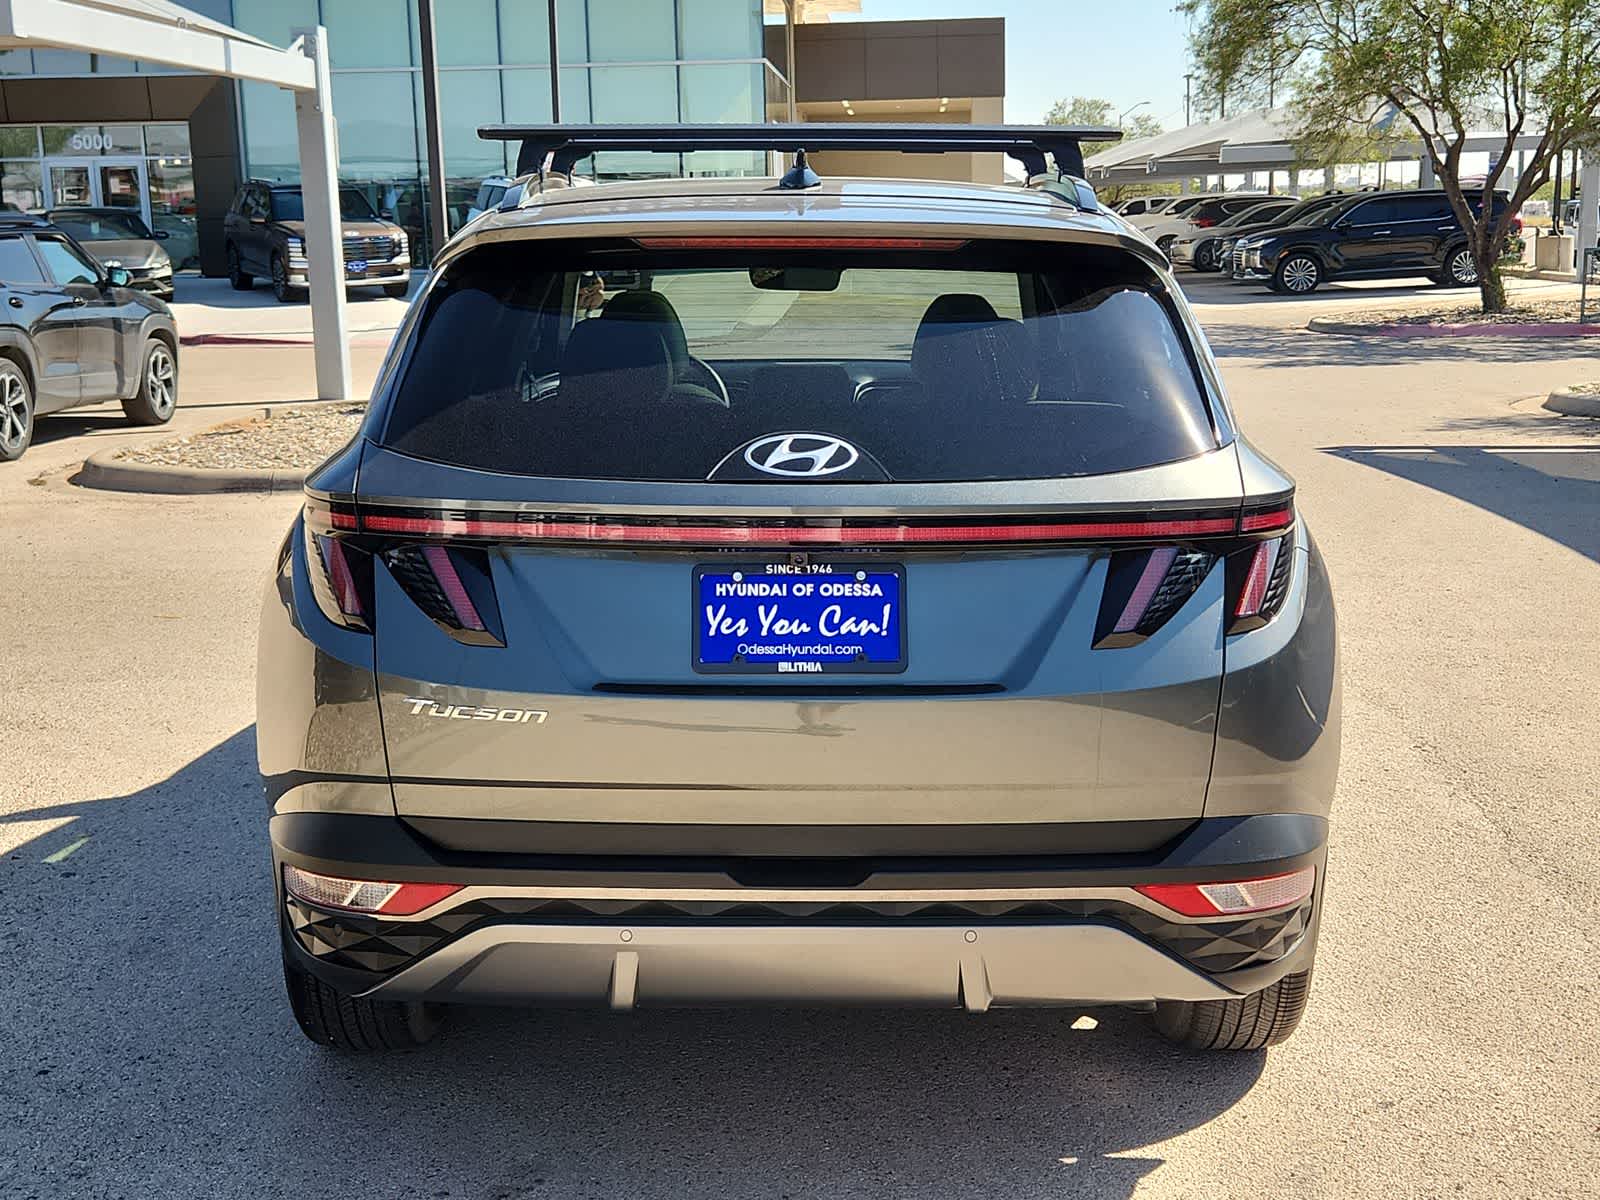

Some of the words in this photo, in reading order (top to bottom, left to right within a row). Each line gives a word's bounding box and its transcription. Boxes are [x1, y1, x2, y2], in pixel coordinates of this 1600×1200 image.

[72, 134, 112, 150] 5000
[765, 564, 802, 574] SINCE
[806, 564, 833, 574] 1946
[715, 583, 787, 597] HYUNDAI
[792, 583, 815, 597] OF
[819, 583, 884, 597] ODESSA
[705, 604, 749, 637] Yes
[757, 604, 811, 637] You
[818, 603, 892, 637] Can!
[737, 643, 863, 657] OdessaHyundai.com
[788, 661, 823, 673] LITHIA
